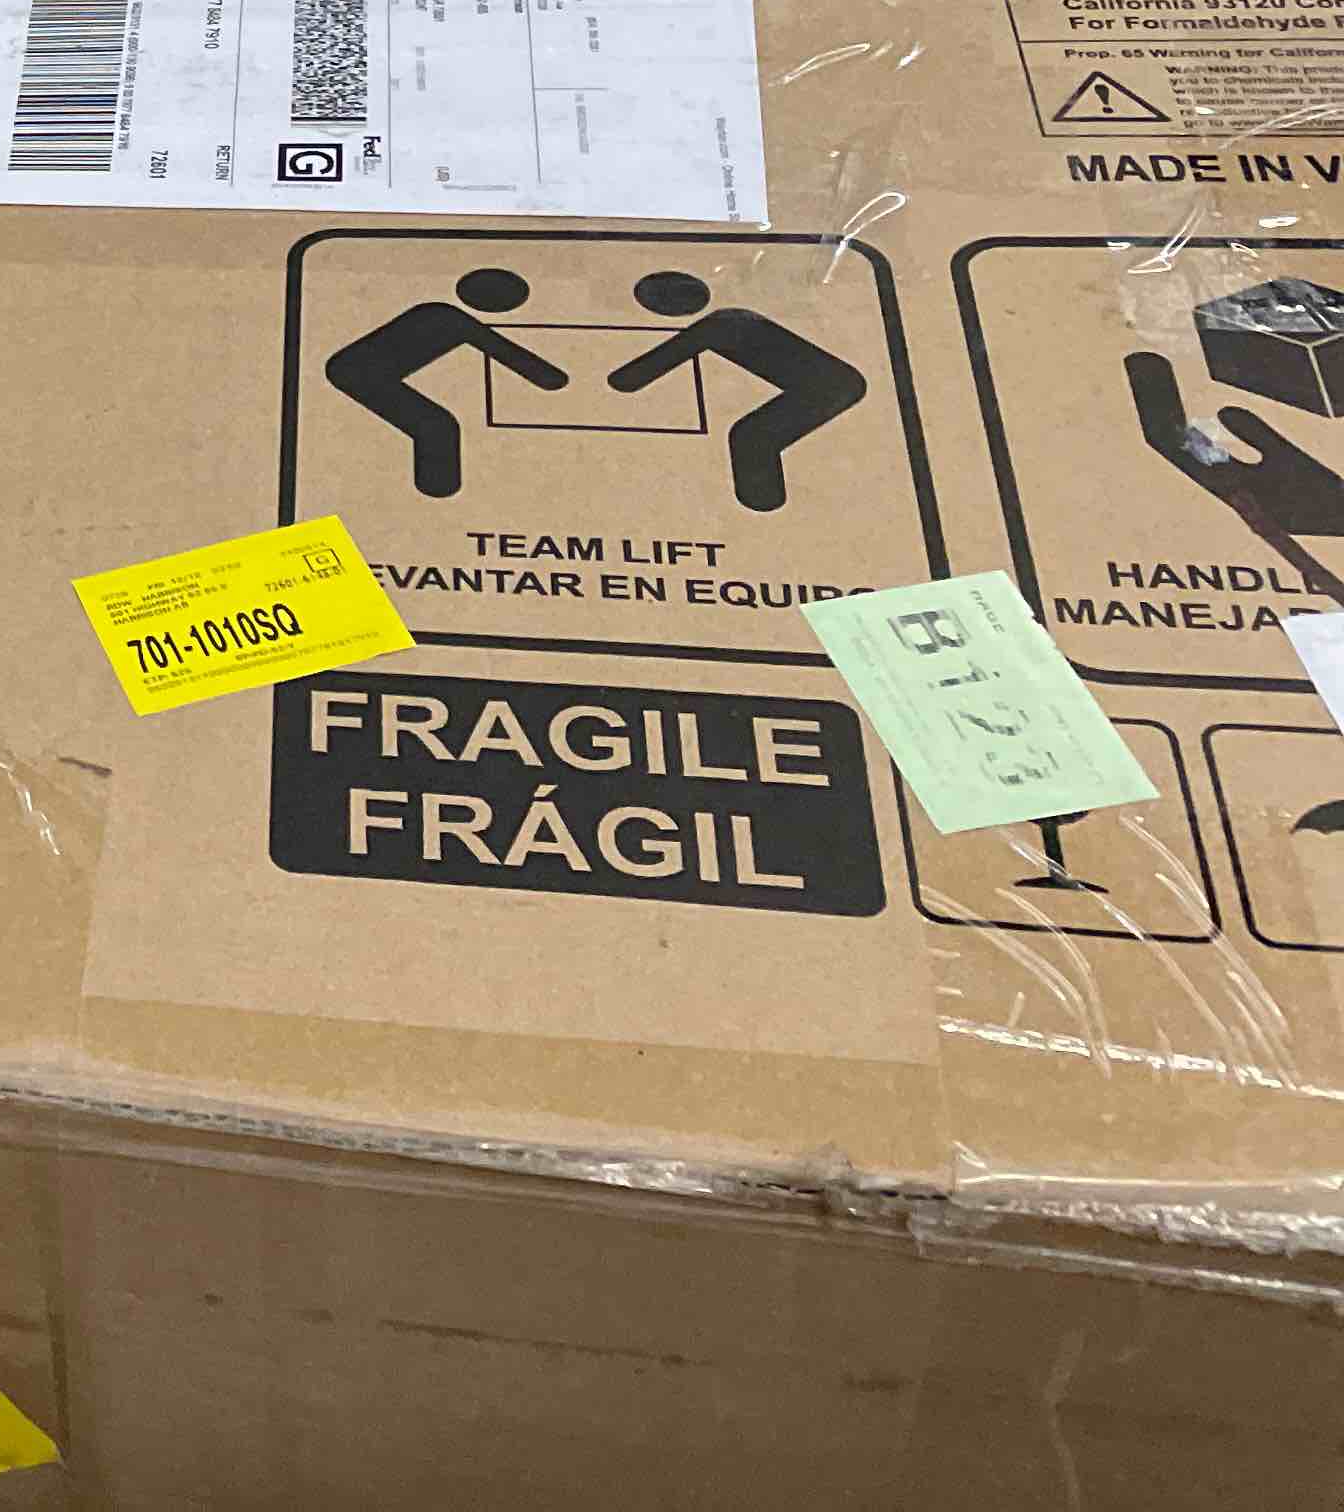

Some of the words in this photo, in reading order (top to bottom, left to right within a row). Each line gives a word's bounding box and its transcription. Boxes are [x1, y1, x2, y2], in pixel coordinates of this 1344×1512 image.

[1069, 16, 1113, 30] For
[1125, 15, 1326, 31] Formaldehyde
[150, 149, 169, 179] 72601
[216, 144, 231, 181] RETURN
[289, 150, 334, 175] G
[1066, 154, 1226, 182] MADE
[1237, 154, 1295, 182] IN
[466, 531, 605, 565] TEAM
[622, 538, 726, 569] LIFT
[369, 563, 584, 597] EVANTAR
[601, 574, 667, 602] EN
[686, 579, 879, 608] EQUIP
[1055, 597, 1324, 631] MANEJA
[127, 603, 304, 673] 701-1010SQ
[887, 609, 1059, 785] B123
[310, 689, 831, 787] FRAGILE
[348, 784, 806, 890] FRÁGIL
